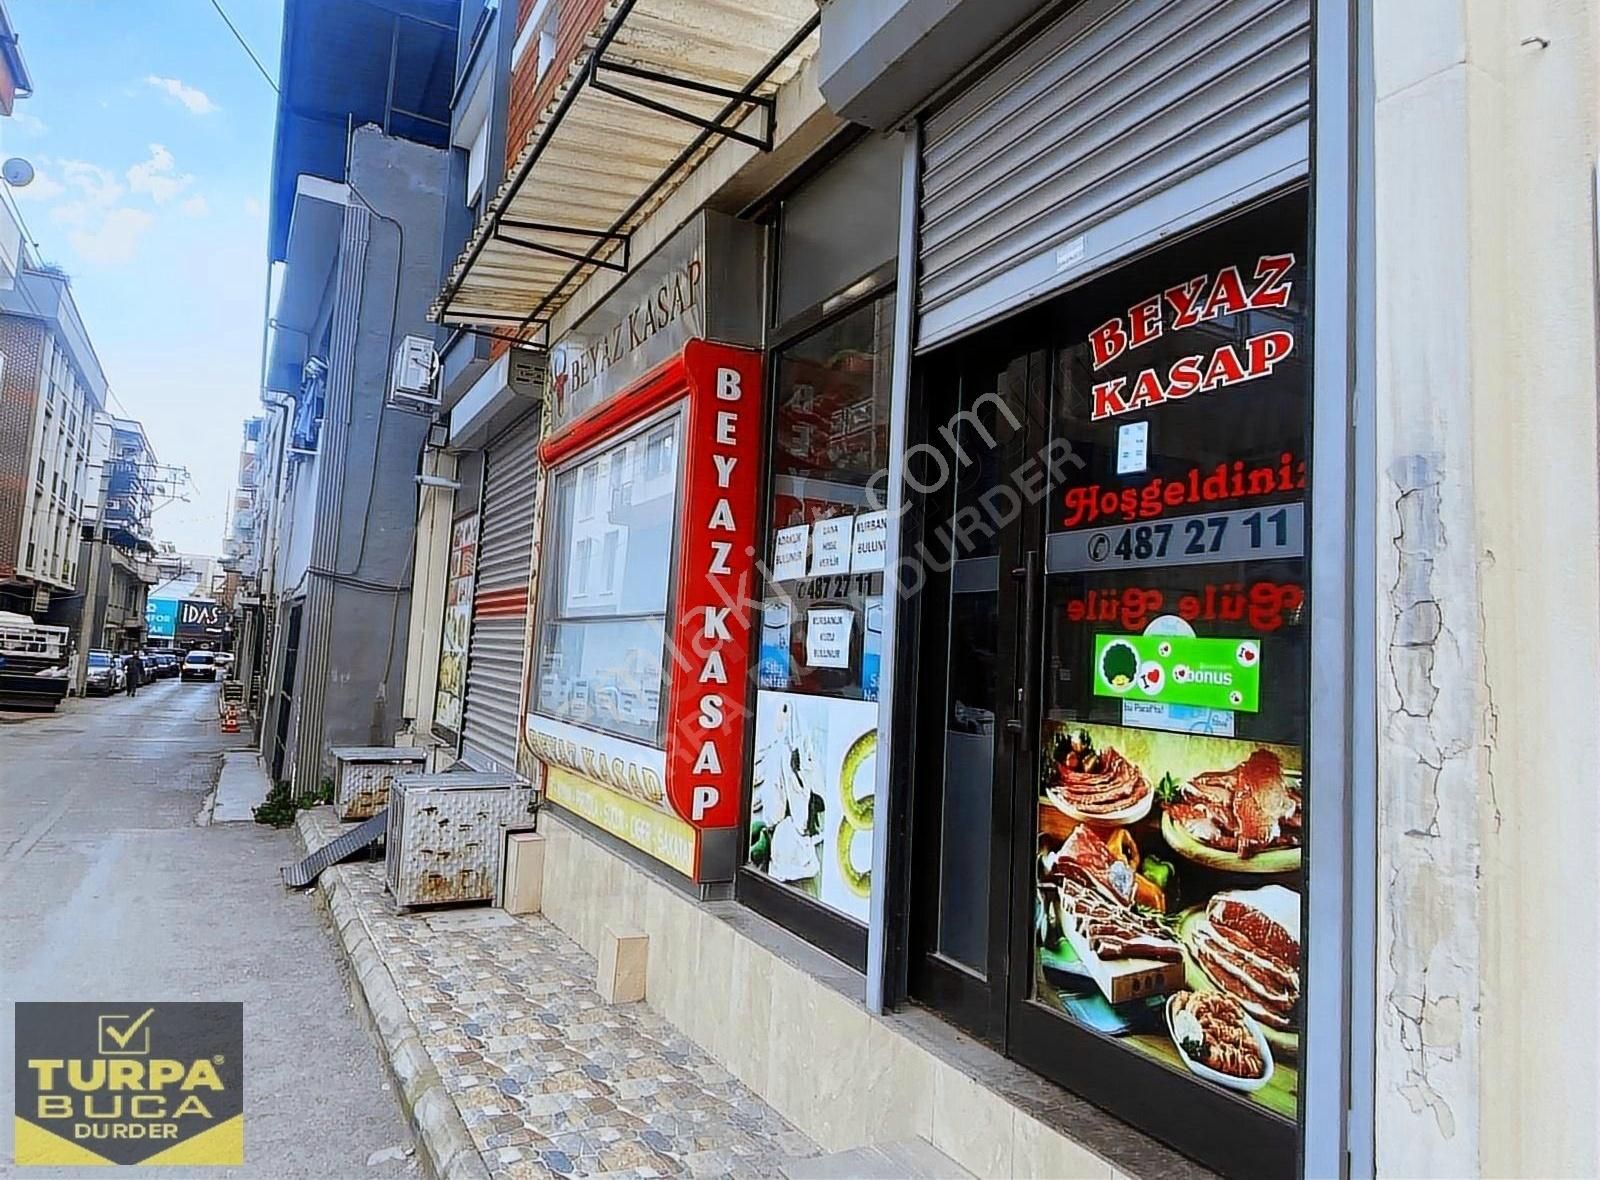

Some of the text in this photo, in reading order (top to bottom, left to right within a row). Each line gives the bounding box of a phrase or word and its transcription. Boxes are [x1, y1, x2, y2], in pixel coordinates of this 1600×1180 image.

[571, 260, 701, 394] BEYAZ KASAP
[1088, 252, 1296, 372] BEYAZ
[1091, 330, 1294, 421] KASAP
[1063, 452, 1305, 527] Hoşgeldini
[1114, 508, 1287, 561] 487 27 11
[691, 367, 742, 821] BEYAZ KASAP
[808, 573, 873, 599] 487 27 11
